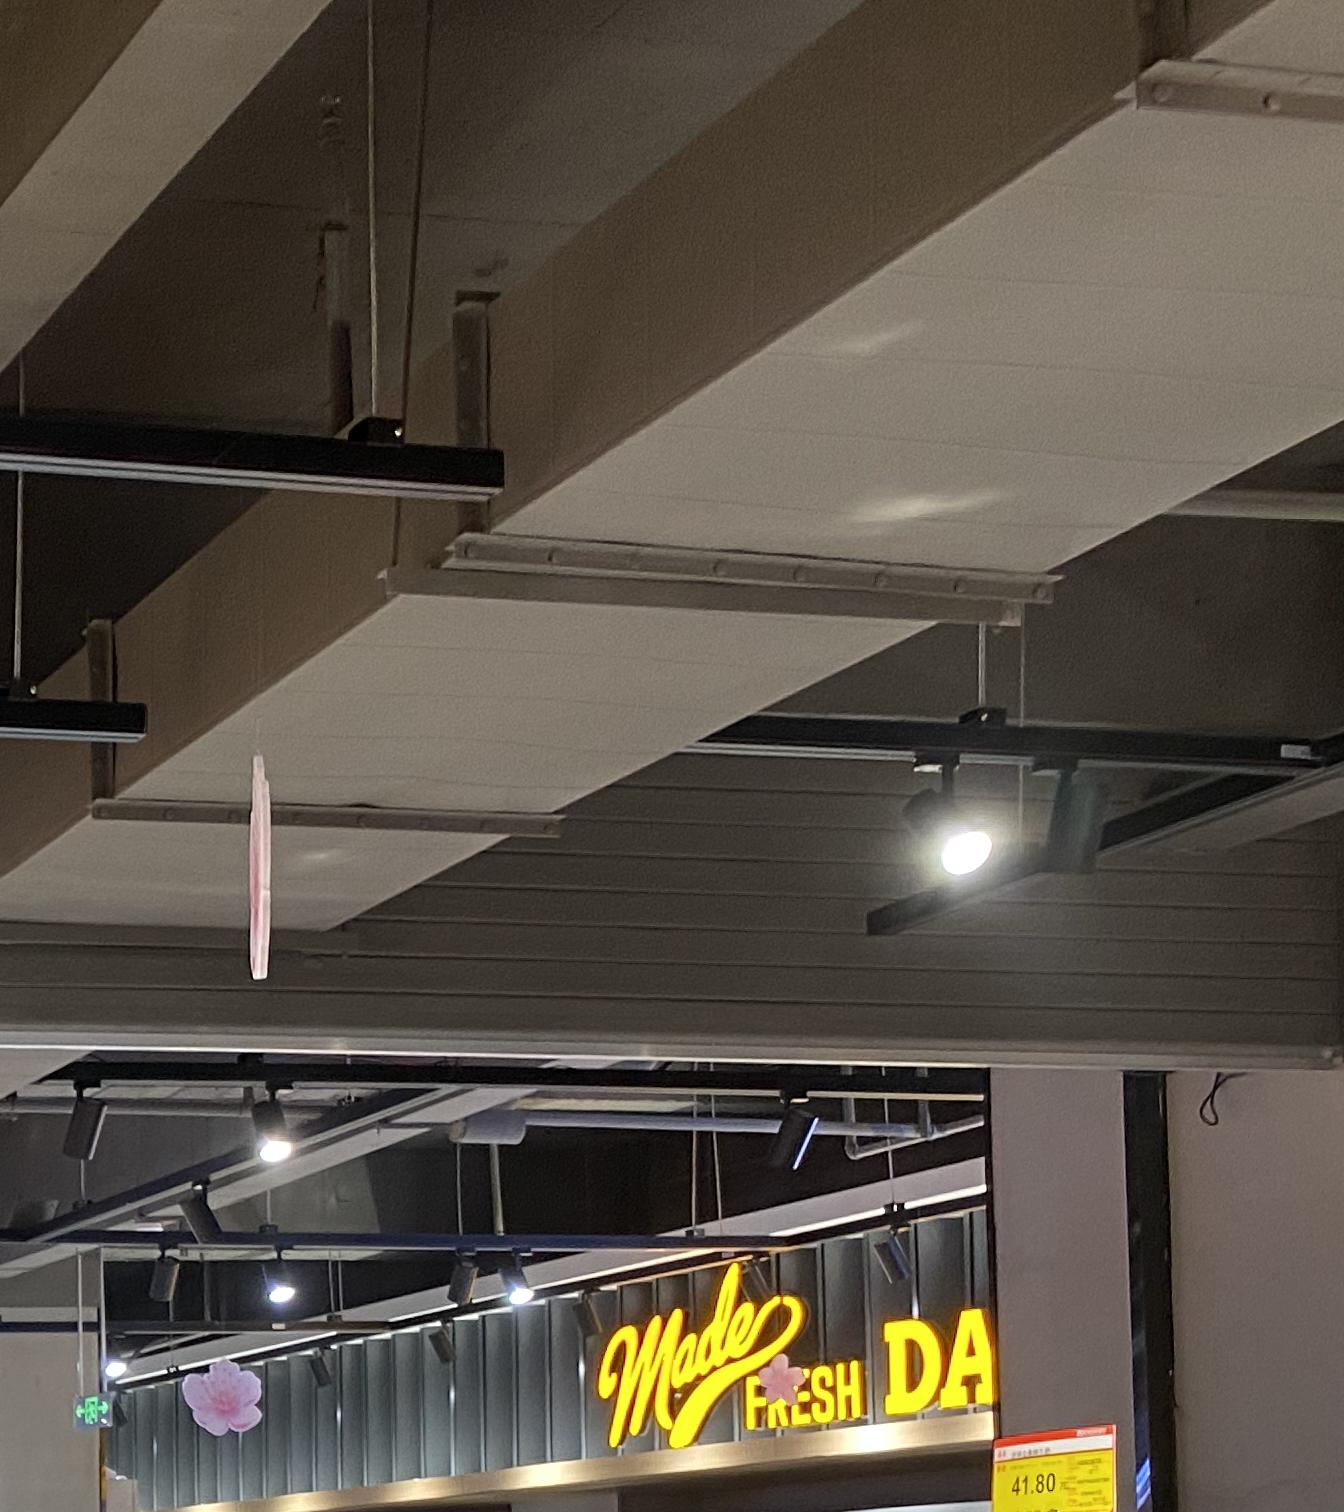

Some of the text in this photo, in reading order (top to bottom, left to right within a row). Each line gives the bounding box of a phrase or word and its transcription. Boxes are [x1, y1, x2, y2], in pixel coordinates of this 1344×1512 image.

[598, 1262, 807, 1448] Made
[883, 1308, 993, 1415] DA
[1011, 1473, 1056, 1496] 41.80
